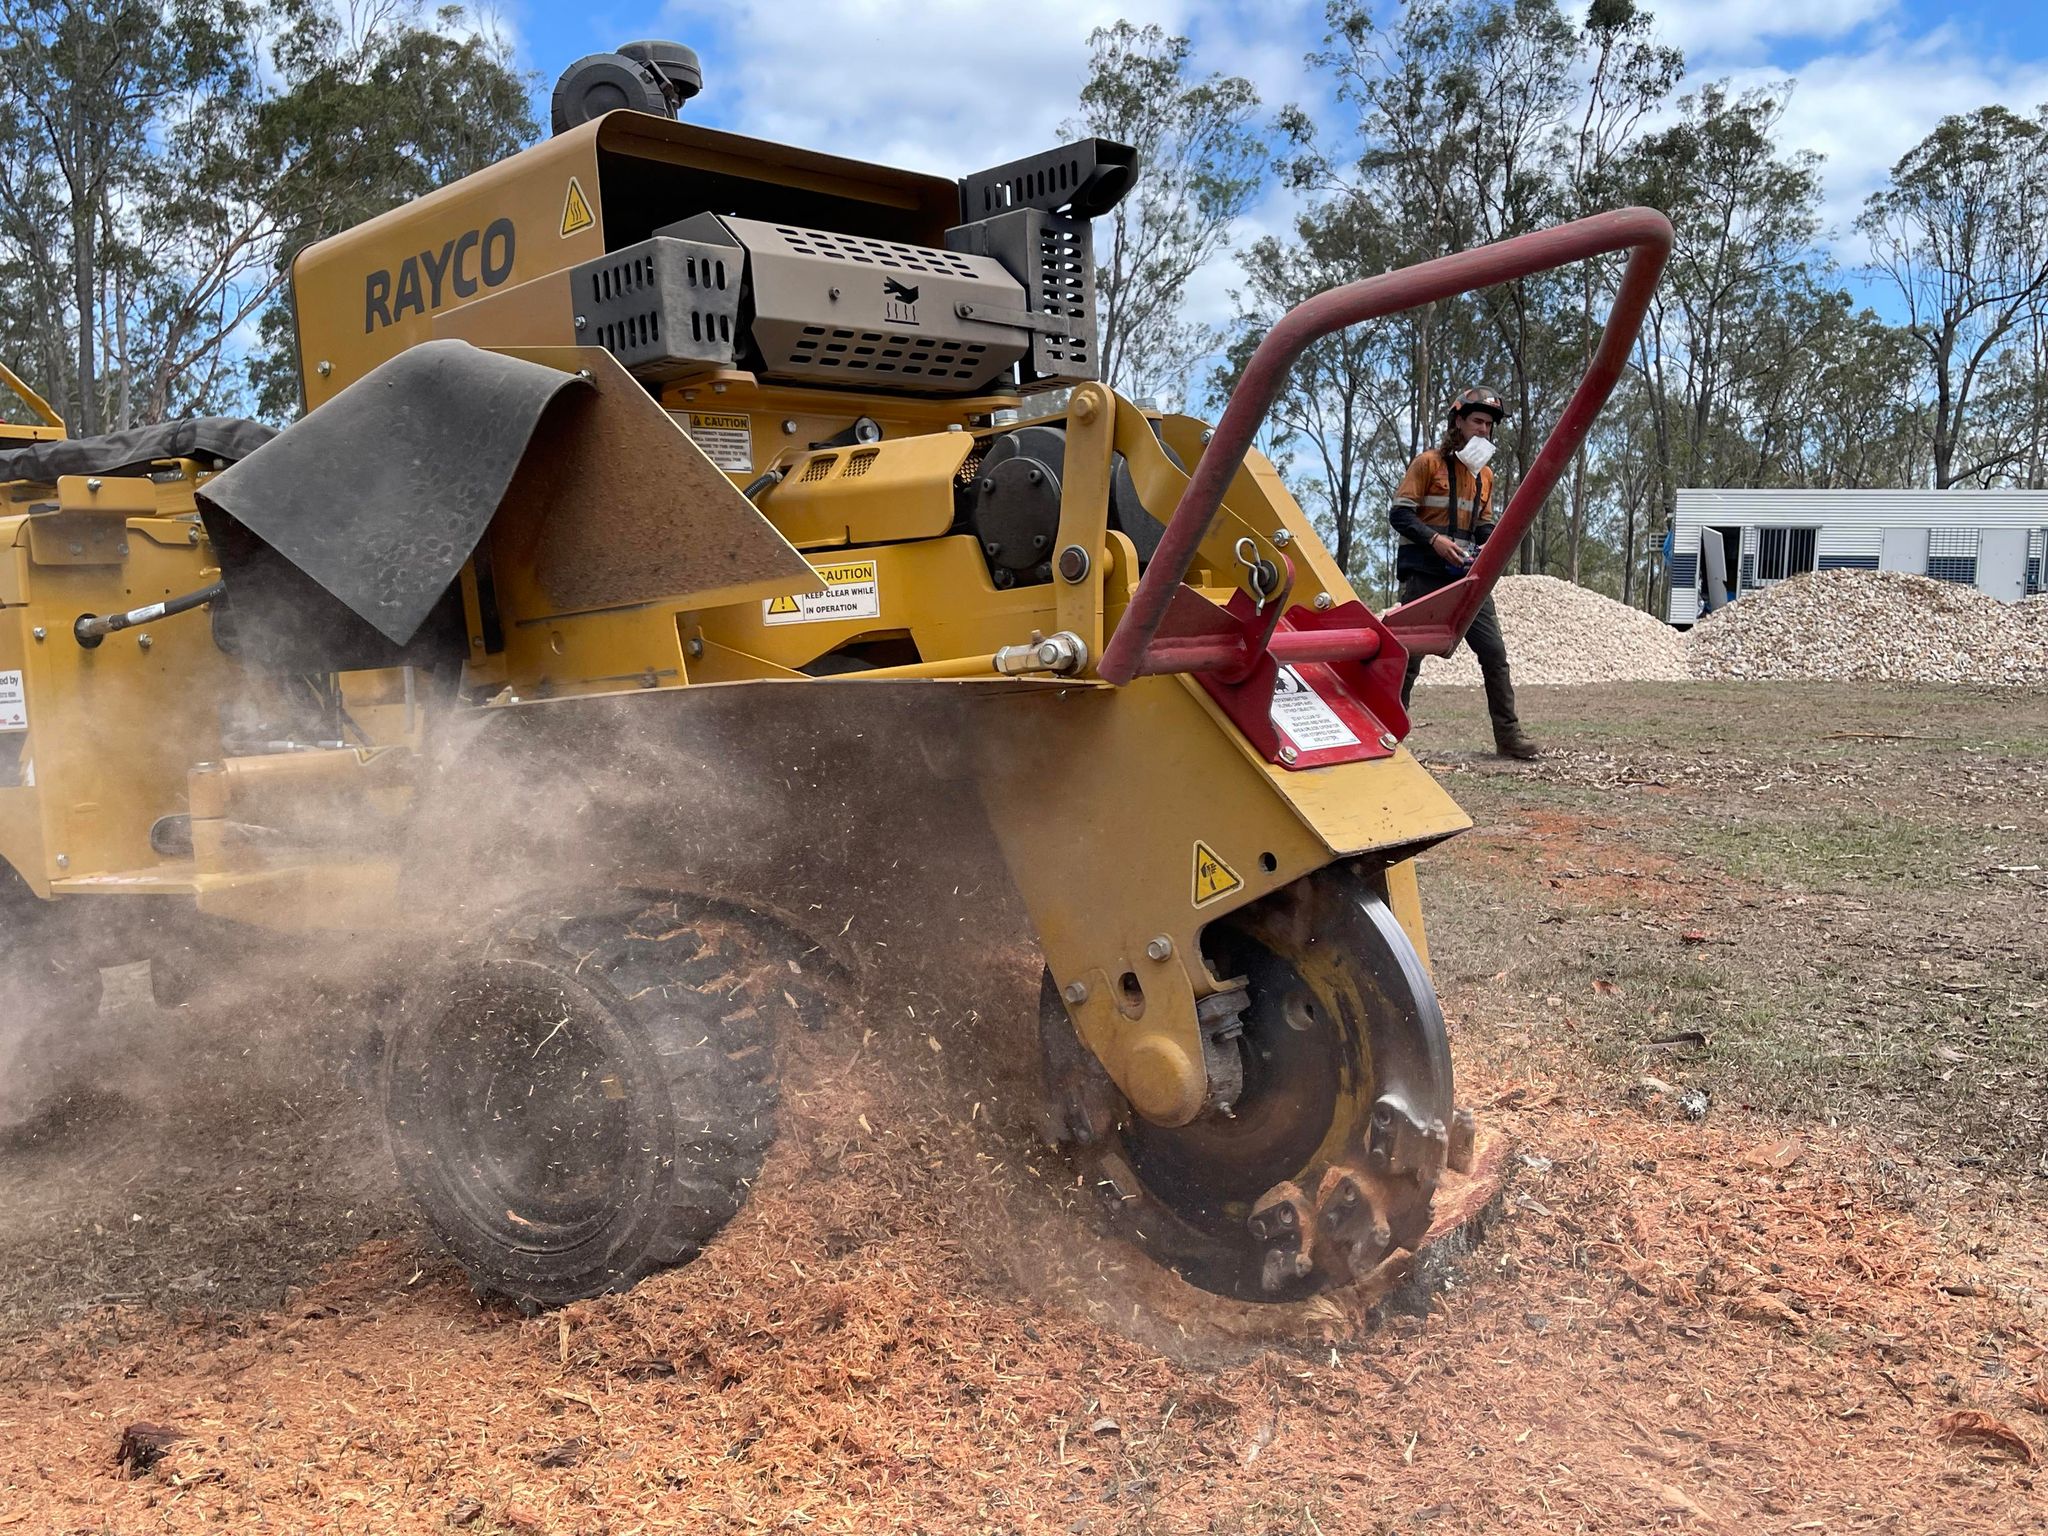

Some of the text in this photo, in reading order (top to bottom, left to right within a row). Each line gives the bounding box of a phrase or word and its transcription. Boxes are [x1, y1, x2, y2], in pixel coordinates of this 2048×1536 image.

[365, 218, 516, 335] RAYCO
[704, 416, 748, 428] CAUTION
[805, 586, 874, 600] KEEP CLEAR WHILE
[816, 603, 858, 614] OPERATION
[9, 675, 19, 687] by
